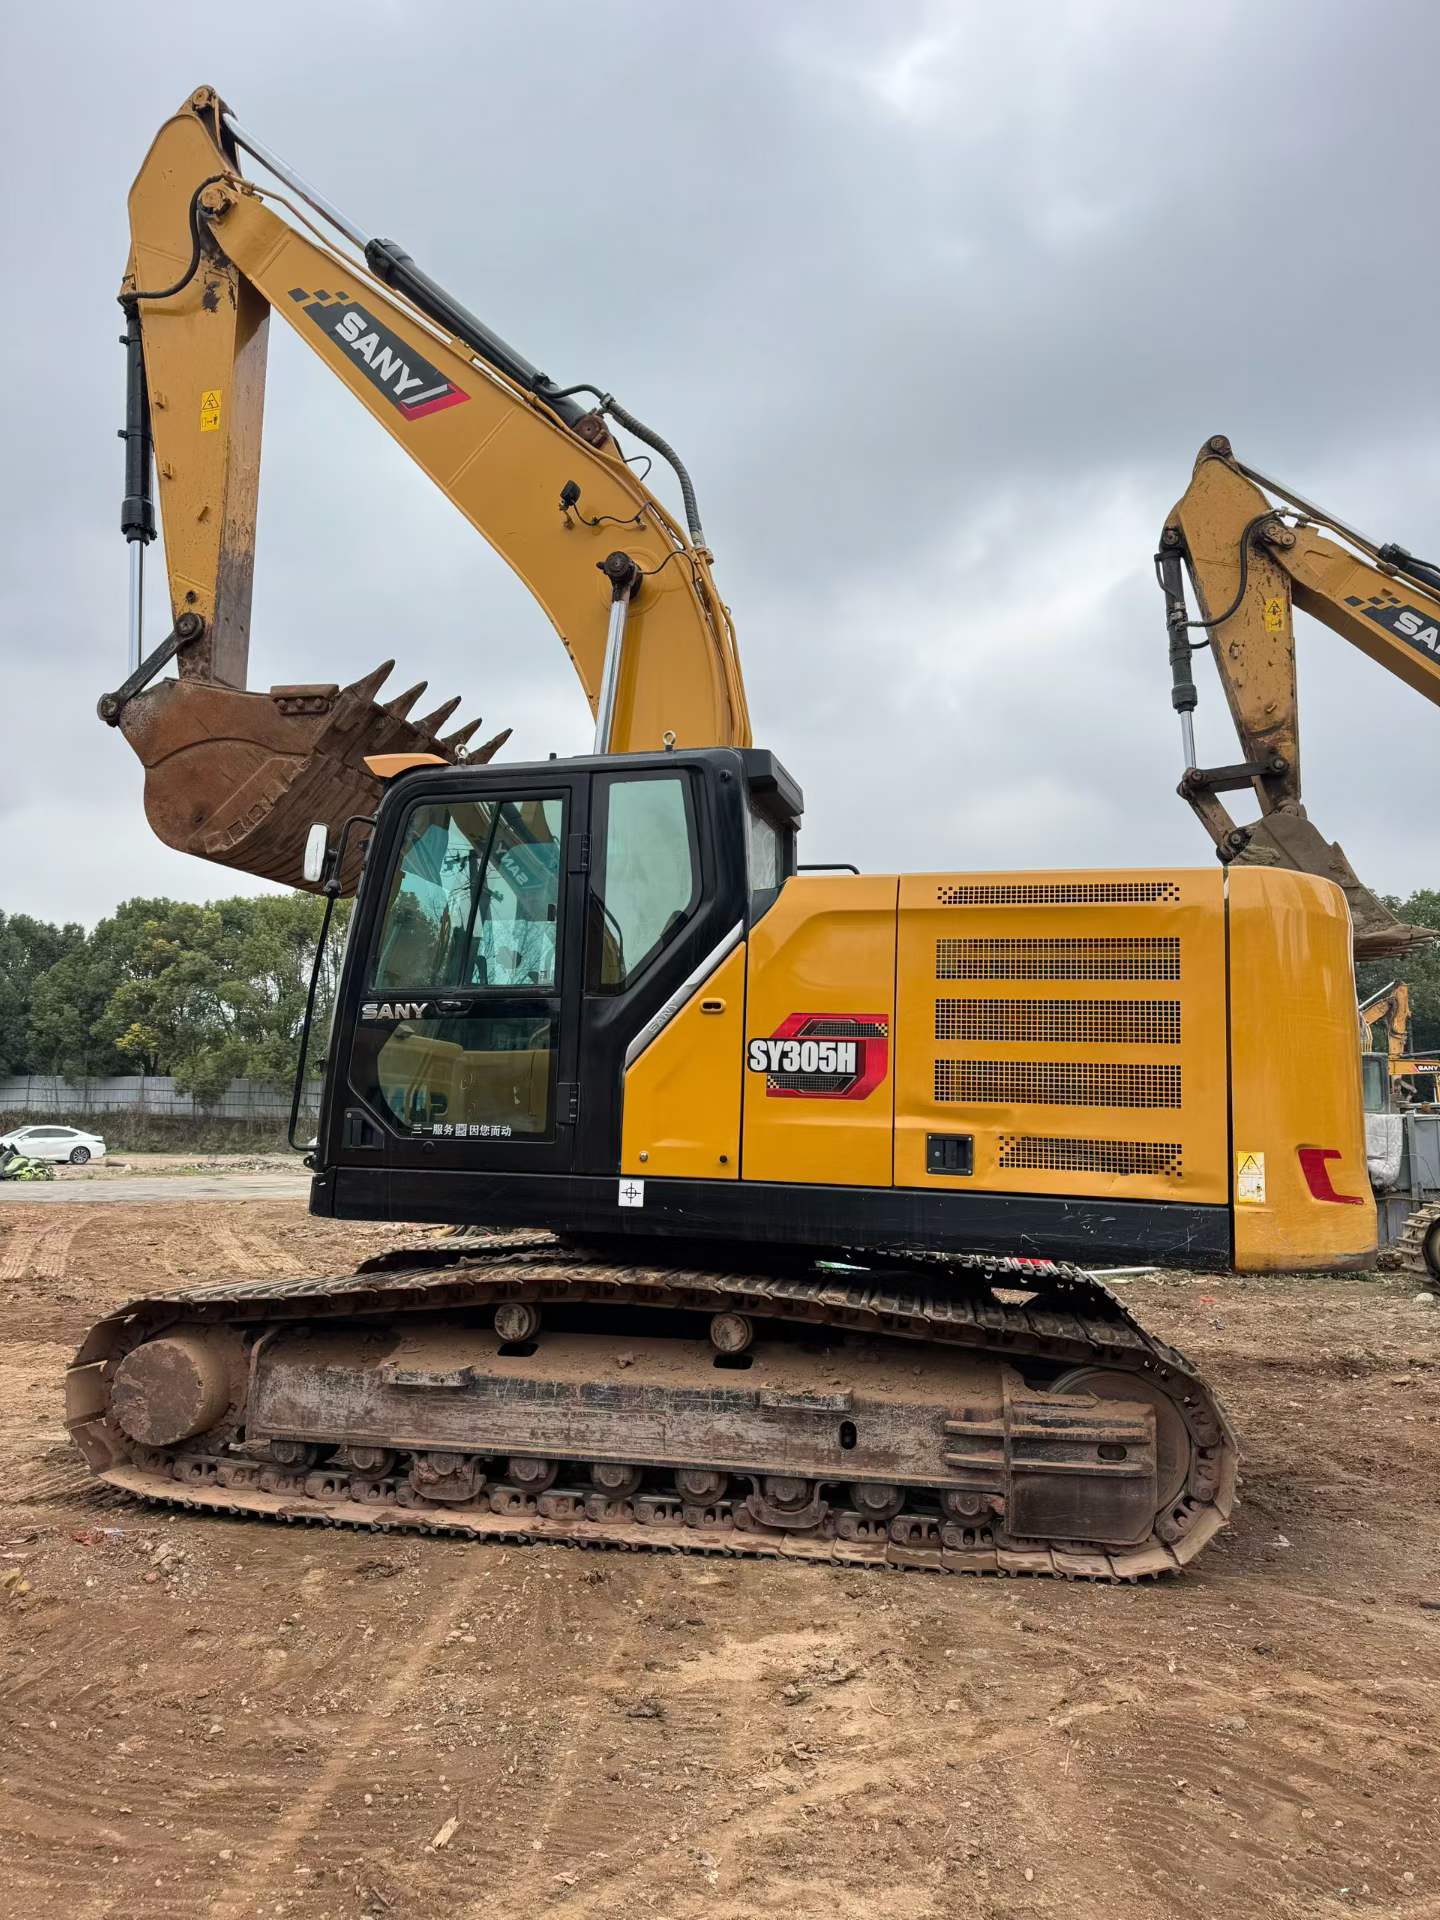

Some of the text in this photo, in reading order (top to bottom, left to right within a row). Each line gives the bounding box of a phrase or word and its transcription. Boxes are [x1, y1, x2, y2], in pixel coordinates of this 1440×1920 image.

[334, 311, 424, 396] SANY
[1393, 611, 1440, 655] SA
[361, 1003, 428, 1020] SANY
[749, 1039, 857, 1073] SY305H
[411, 1123, 512, 1137] 三一服务 因您而动
